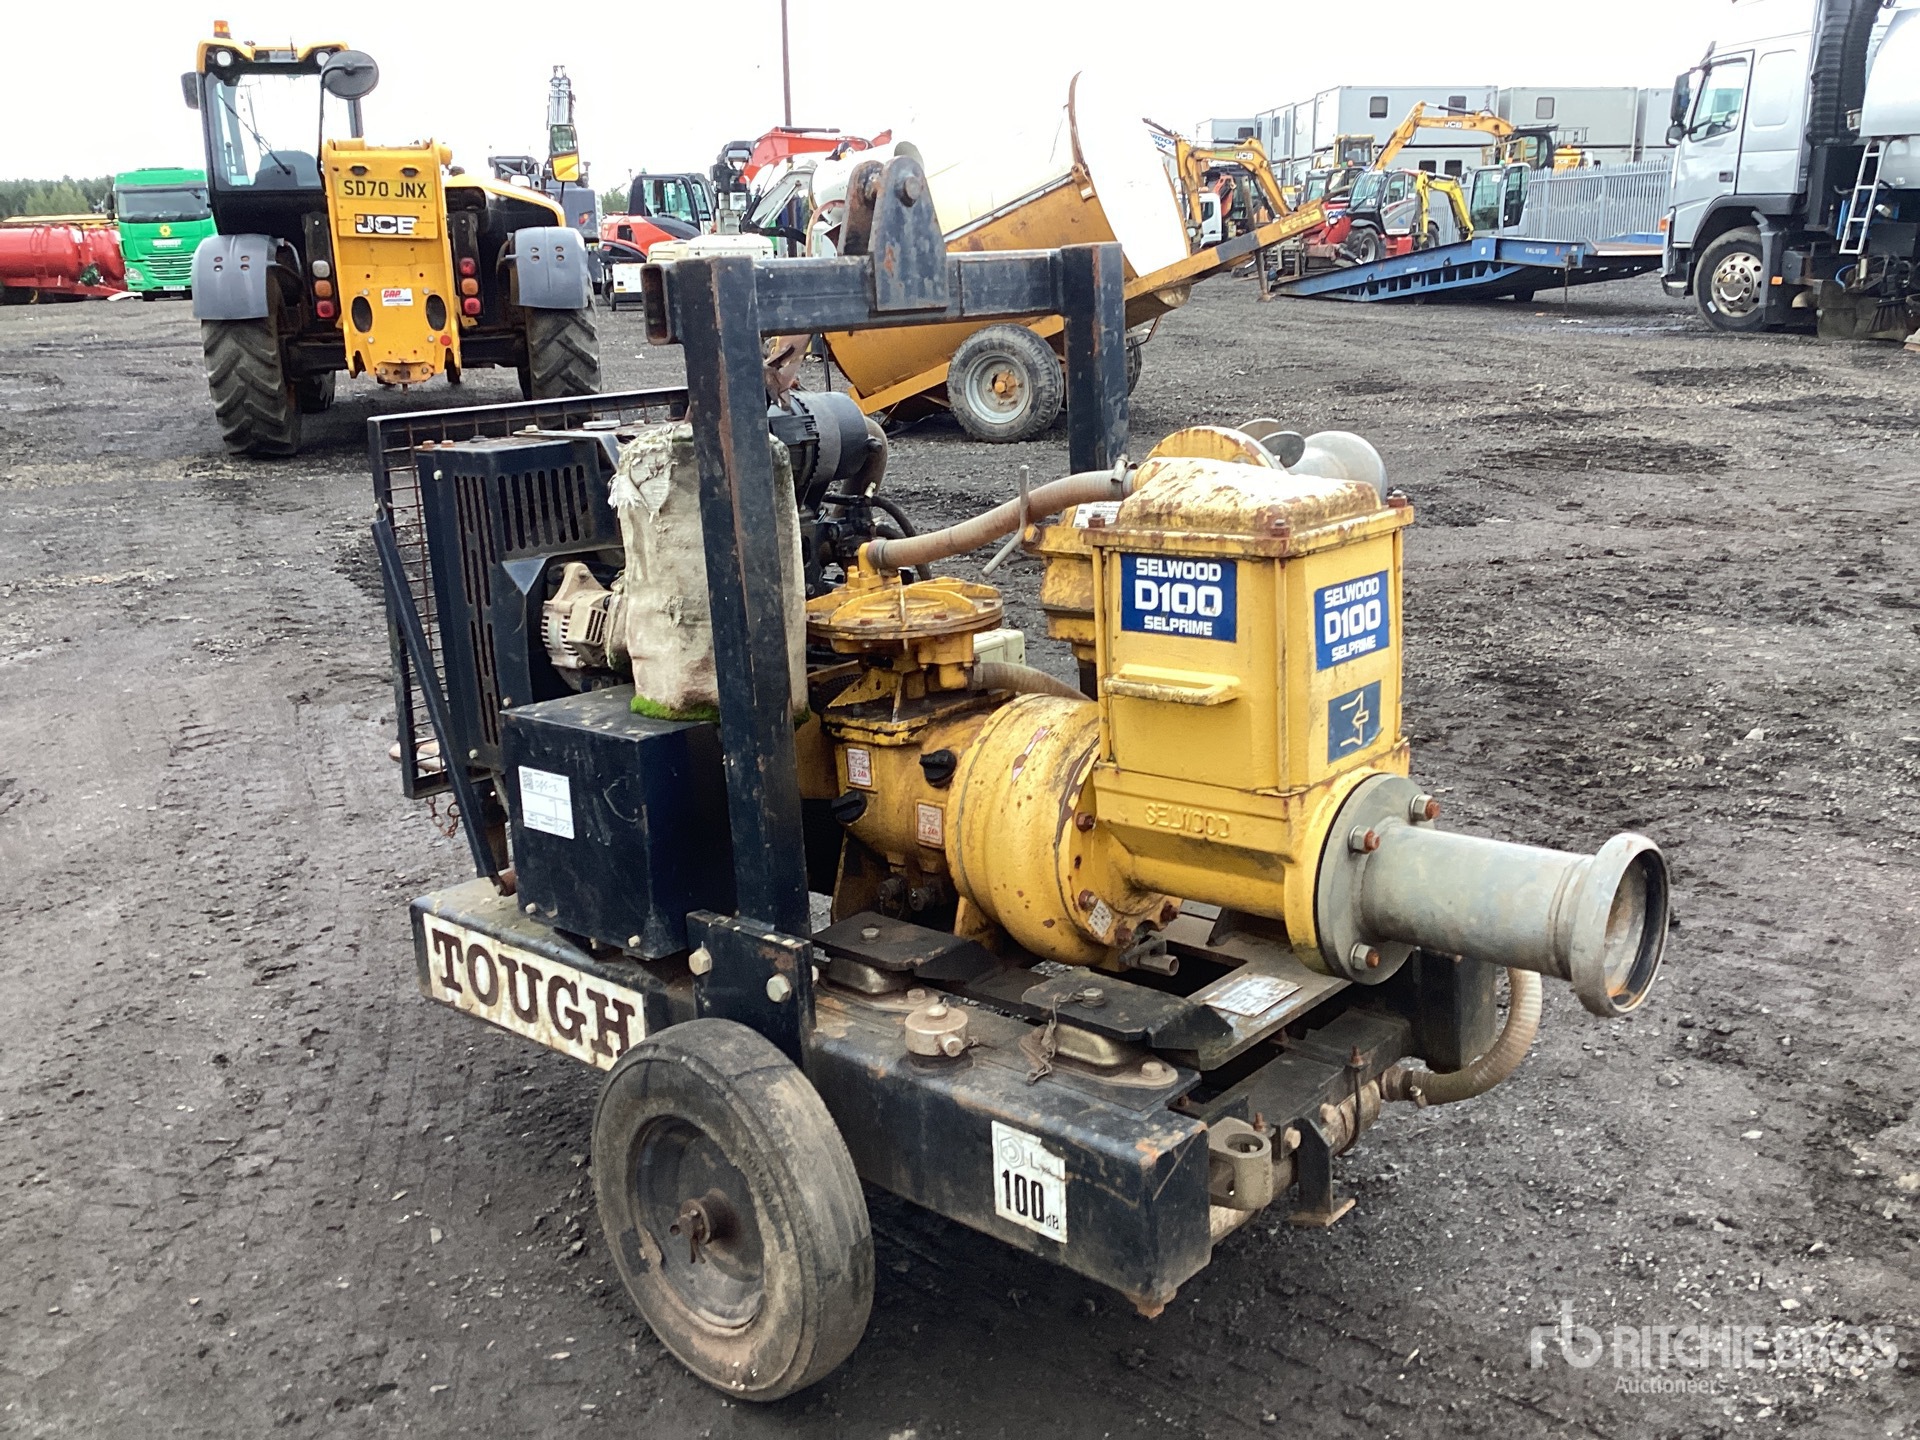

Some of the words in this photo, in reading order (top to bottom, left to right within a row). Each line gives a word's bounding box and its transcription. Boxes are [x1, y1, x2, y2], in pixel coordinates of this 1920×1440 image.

[1235, 151, 1254, 160] JCB
[344, 180, 389, 197] SD70
[395, 182, 427, 198] JNX
[356, 215, 418, 235] JCB
[383, 290, 402, 298] GAP
[1136, 557, 1222, 582] SELWOOD
[1134, 578, 1223, 618] D100
[1324, 577, 1380, 609] SELWOOD
[1144, 615, 1213, 636] SELPRIME
[1323, 598, 1382, 645] D100
[1331, 634, 1376, 662] SELPRIME
[431, 928, 635, 1058] TOUGH
[1001, 1169, 1045, 1223] 100
[1045, 1214, 1059, 1230] dB
